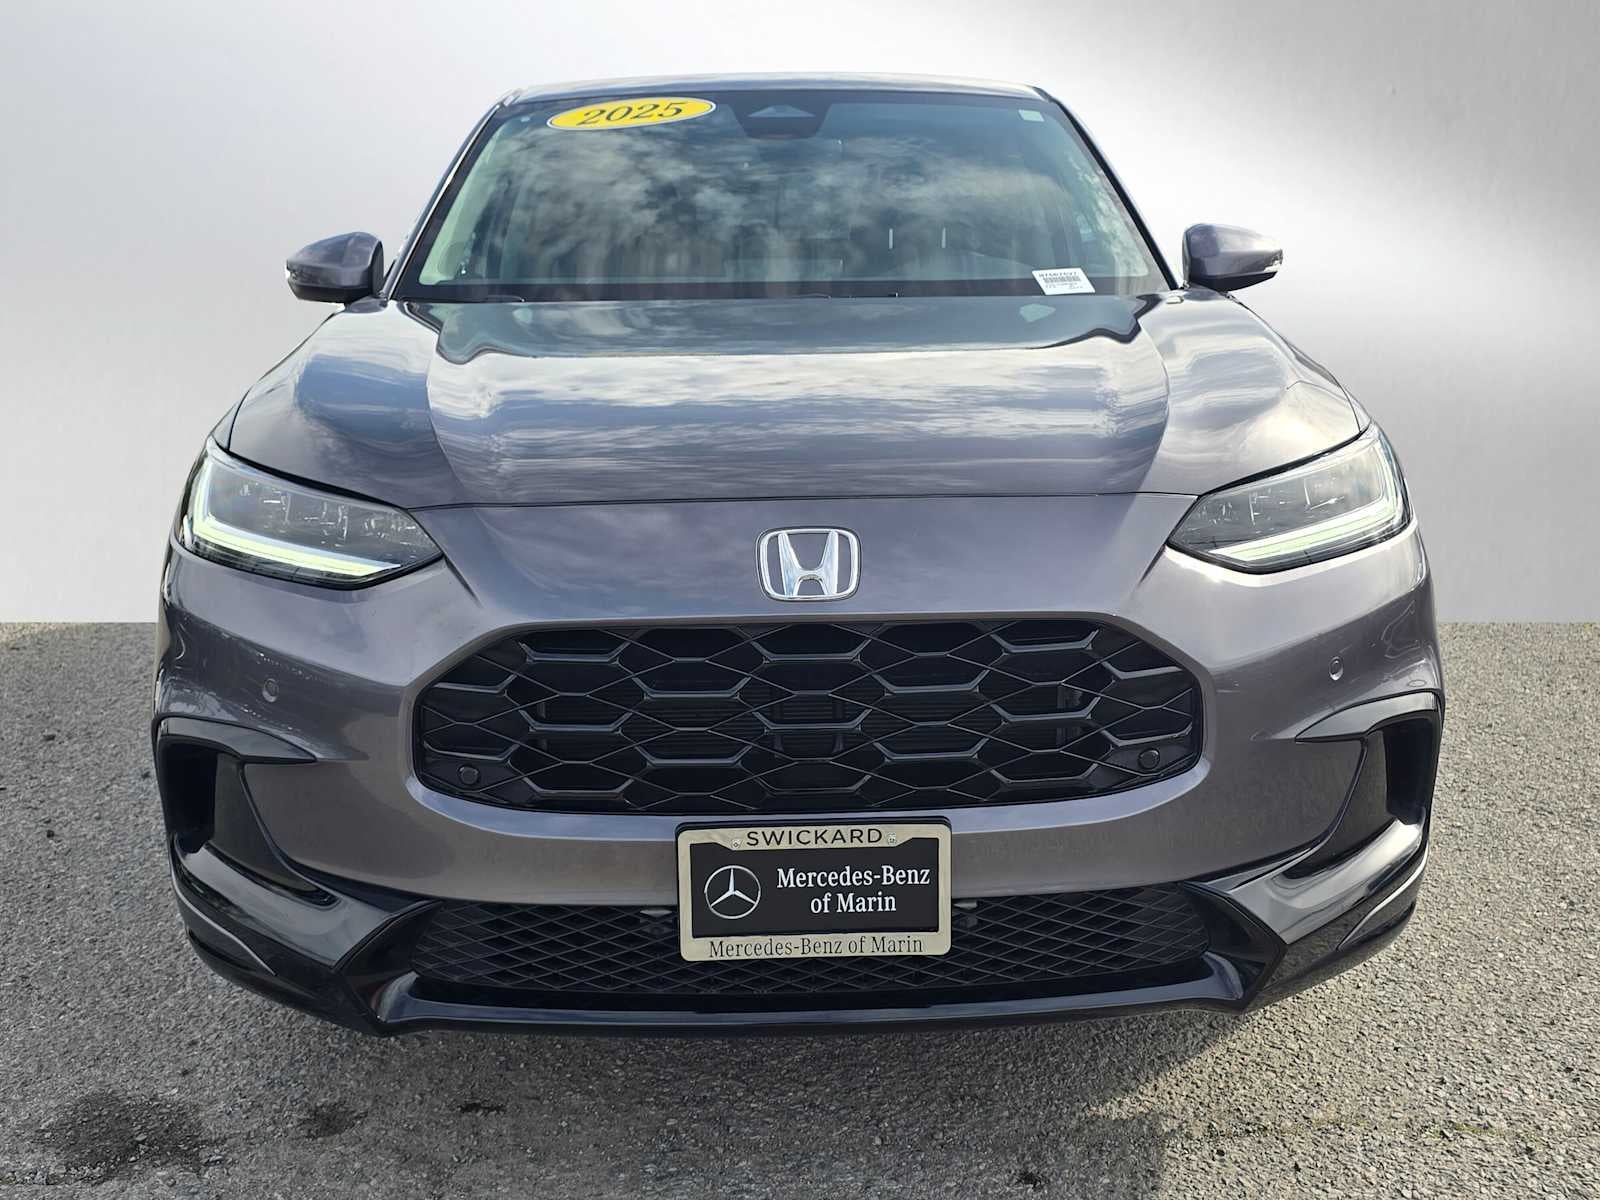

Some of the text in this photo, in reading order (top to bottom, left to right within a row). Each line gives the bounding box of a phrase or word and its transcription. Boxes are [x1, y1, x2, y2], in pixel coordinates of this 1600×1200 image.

[576, 101, 688, 126] 2025
[746, 828, 882, 846] SWICKARD
[777, 865, 930, 888] Mercedes-Benz
[810, 892, 896, 913] of Marin
[709, 935, 923, 958] Mercedes-Benz of Marin
